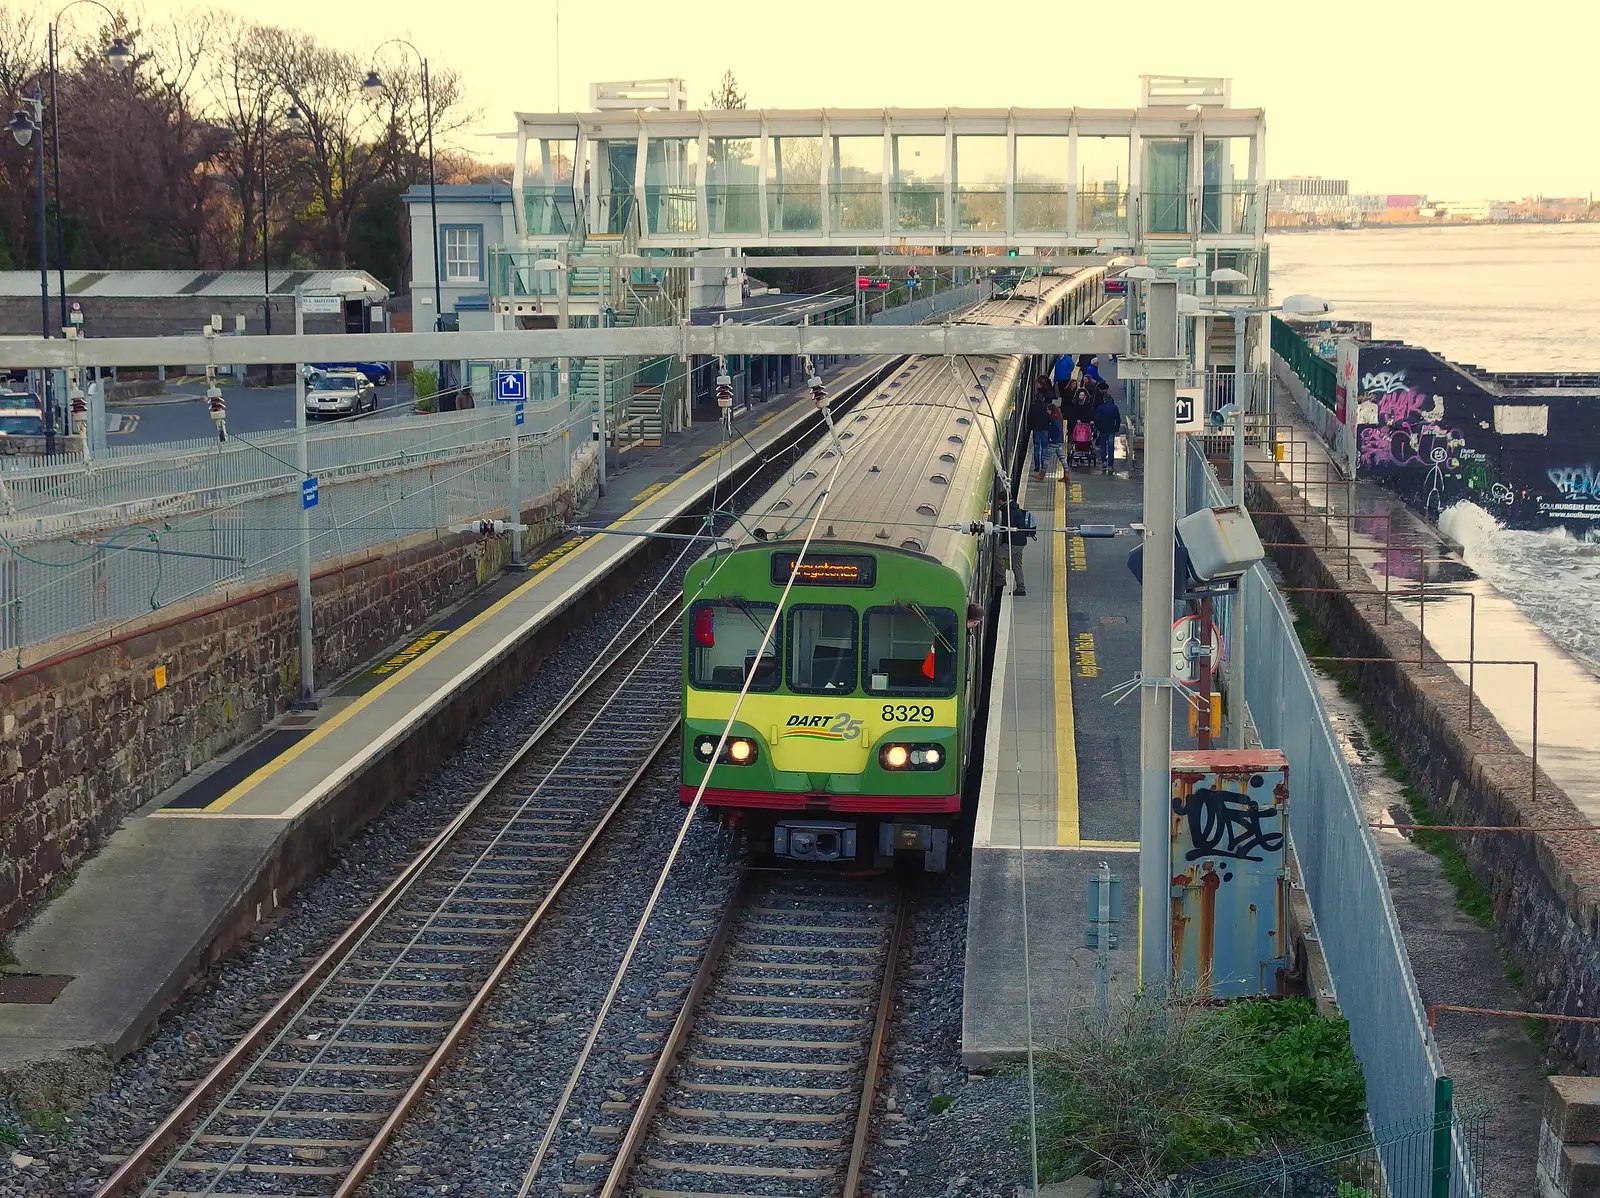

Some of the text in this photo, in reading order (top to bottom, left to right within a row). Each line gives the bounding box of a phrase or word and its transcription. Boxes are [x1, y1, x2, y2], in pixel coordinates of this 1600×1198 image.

[1540, 503, 1584, 511] SOULBURGERS
[881, 704, 934, 722] 8329
[786, 713, 864, 740] DART 25
